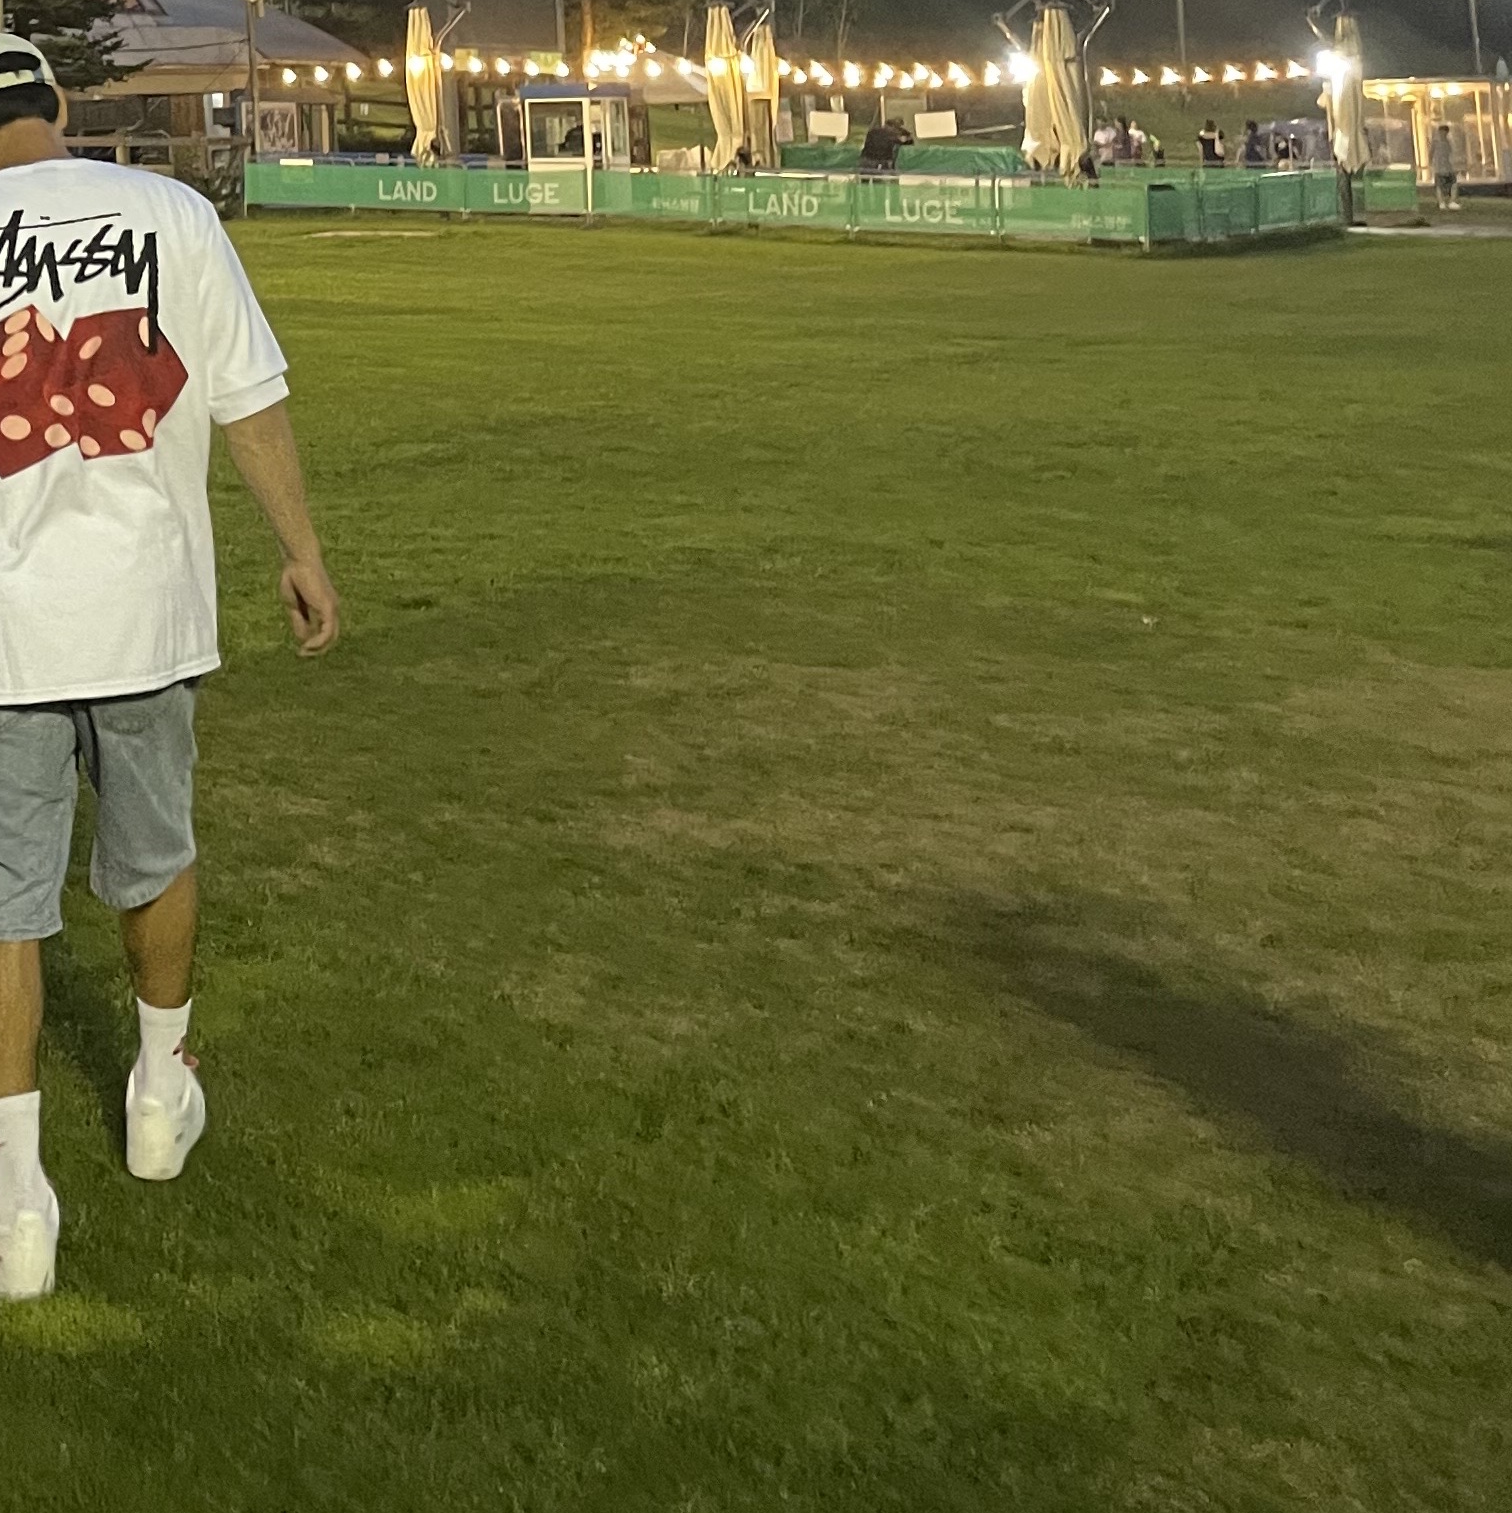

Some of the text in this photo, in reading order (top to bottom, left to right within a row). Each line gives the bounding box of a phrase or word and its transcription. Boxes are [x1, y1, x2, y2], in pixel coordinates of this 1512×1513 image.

[378, 179, 560, 205] LAND LUGE
[748, 191, 964, 225] LAND LUGE
